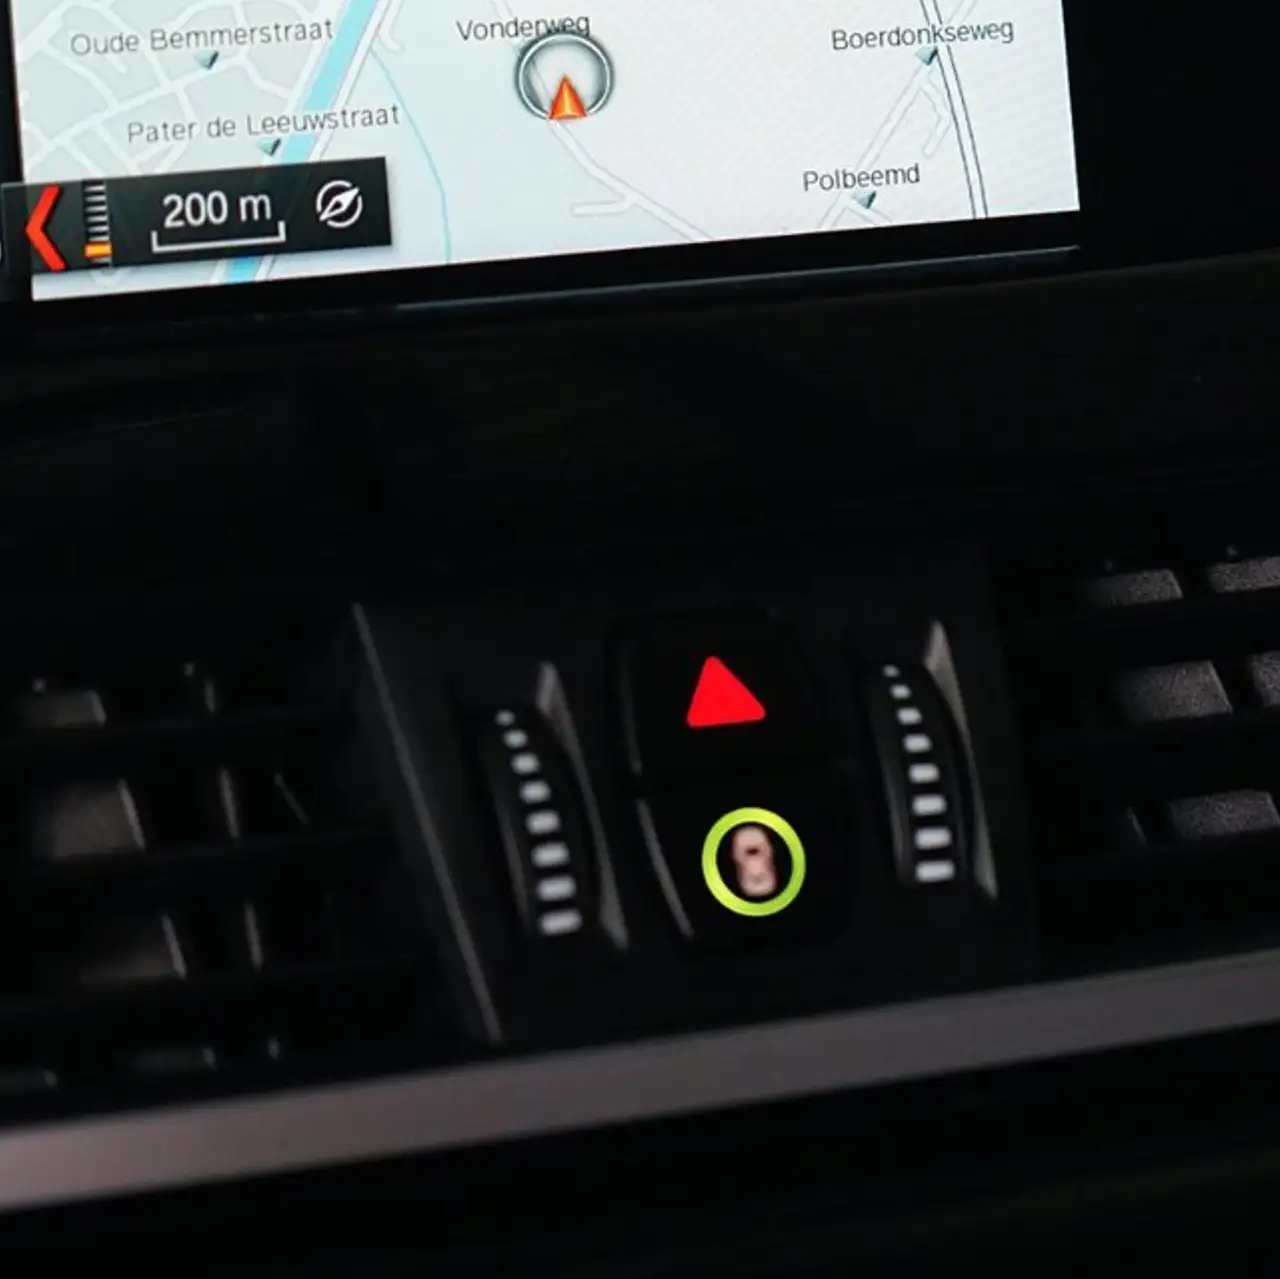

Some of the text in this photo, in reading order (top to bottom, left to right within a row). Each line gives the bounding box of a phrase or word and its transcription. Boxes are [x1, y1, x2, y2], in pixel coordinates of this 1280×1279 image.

[70, 19, 333, 56] Oude Bemmerstraat
[456, 15, 591, 41] Vonderweg
[831, 20, 1015, 51] Boerdonkseweg
[127, 105, 401, 145] Pater de Leeuwstraat
[802, 164, 921, 192] Polbeemd
[163, 192, 273, 228] 200 m
